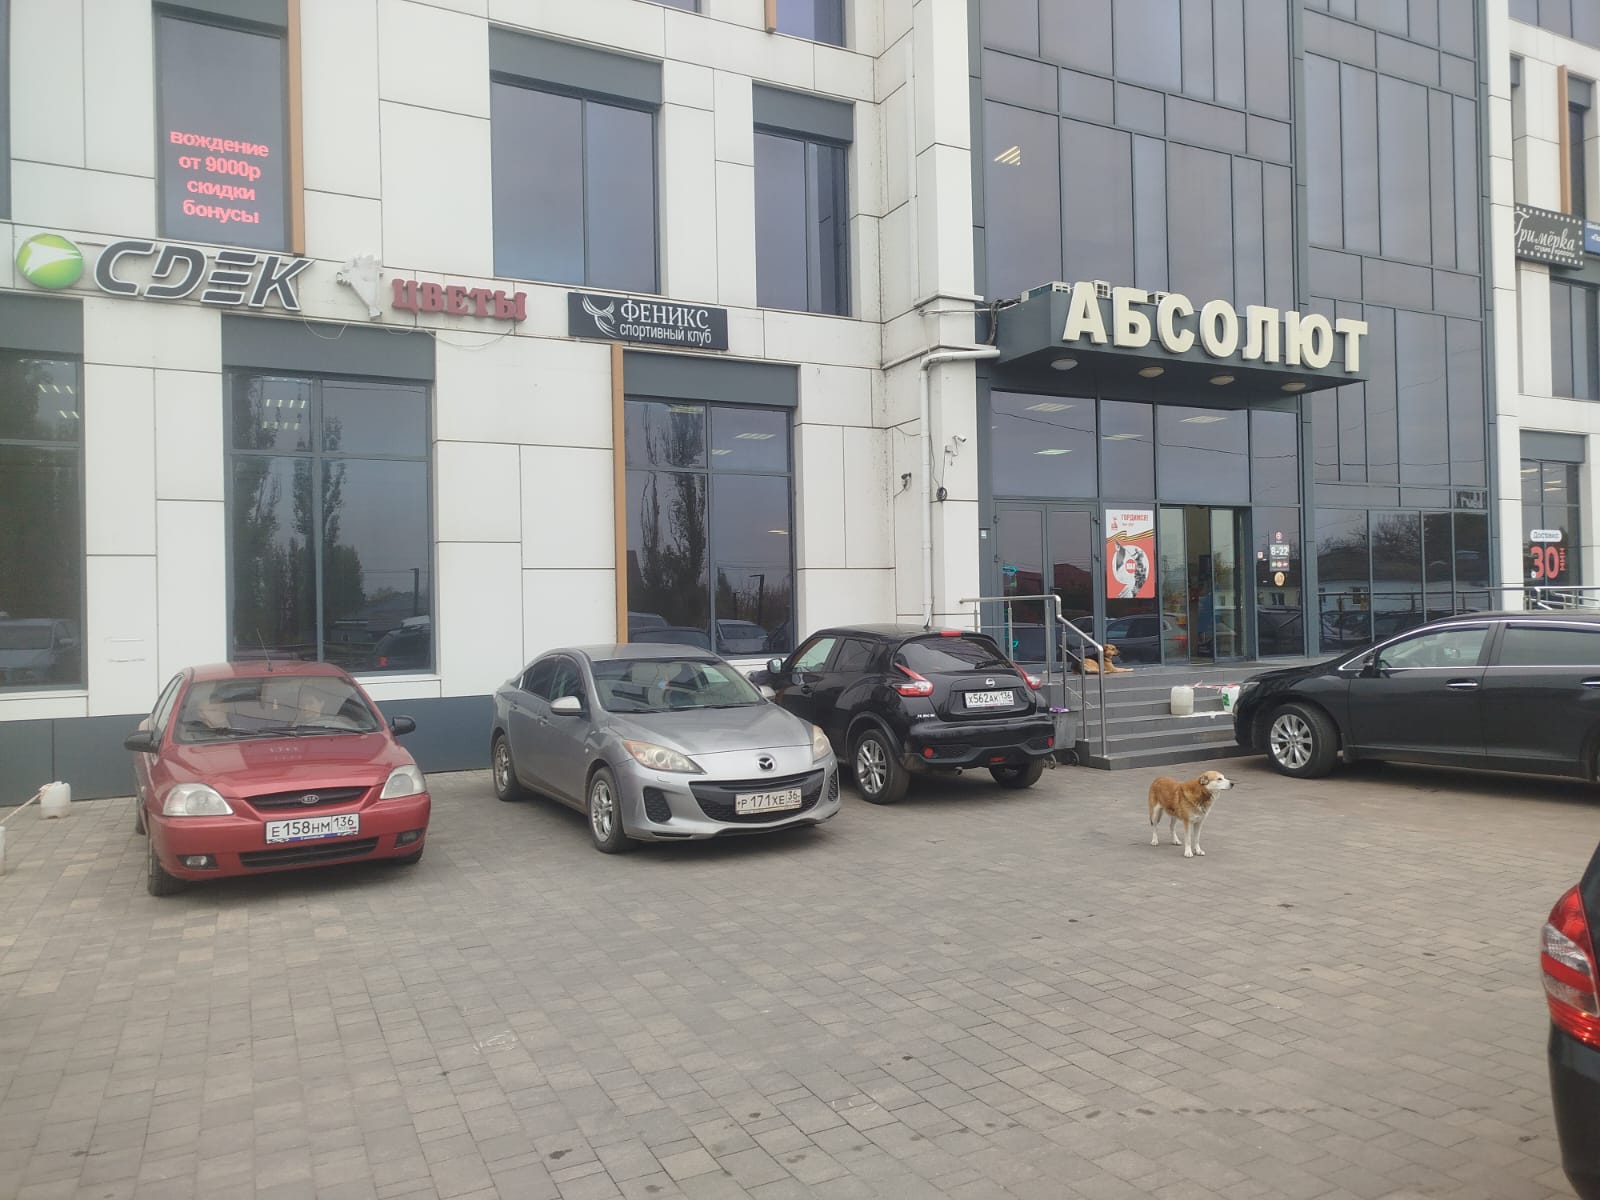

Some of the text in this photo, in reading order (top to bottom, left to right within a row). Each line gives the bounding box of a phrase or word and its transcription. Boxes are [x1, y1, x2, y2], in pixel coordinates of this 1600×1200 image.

[170, 131, 269, 158] вождение
[178, 155, 261, 181] от 9000р
[186, 180, 256, 201] скидки
[182, 200, 260, 224] бонусы
[391, 278, 528, 322] ЦВЕТЫ
[620, 299, 709, 329] ФЕНИКС
[1062, 281, 1369, 373] АБСОЛЮТ
[619, 323, 712, 347] спортивный клуб
[1530, 545, 1560, 579] 30
[333, 816, 354, 828] 136
